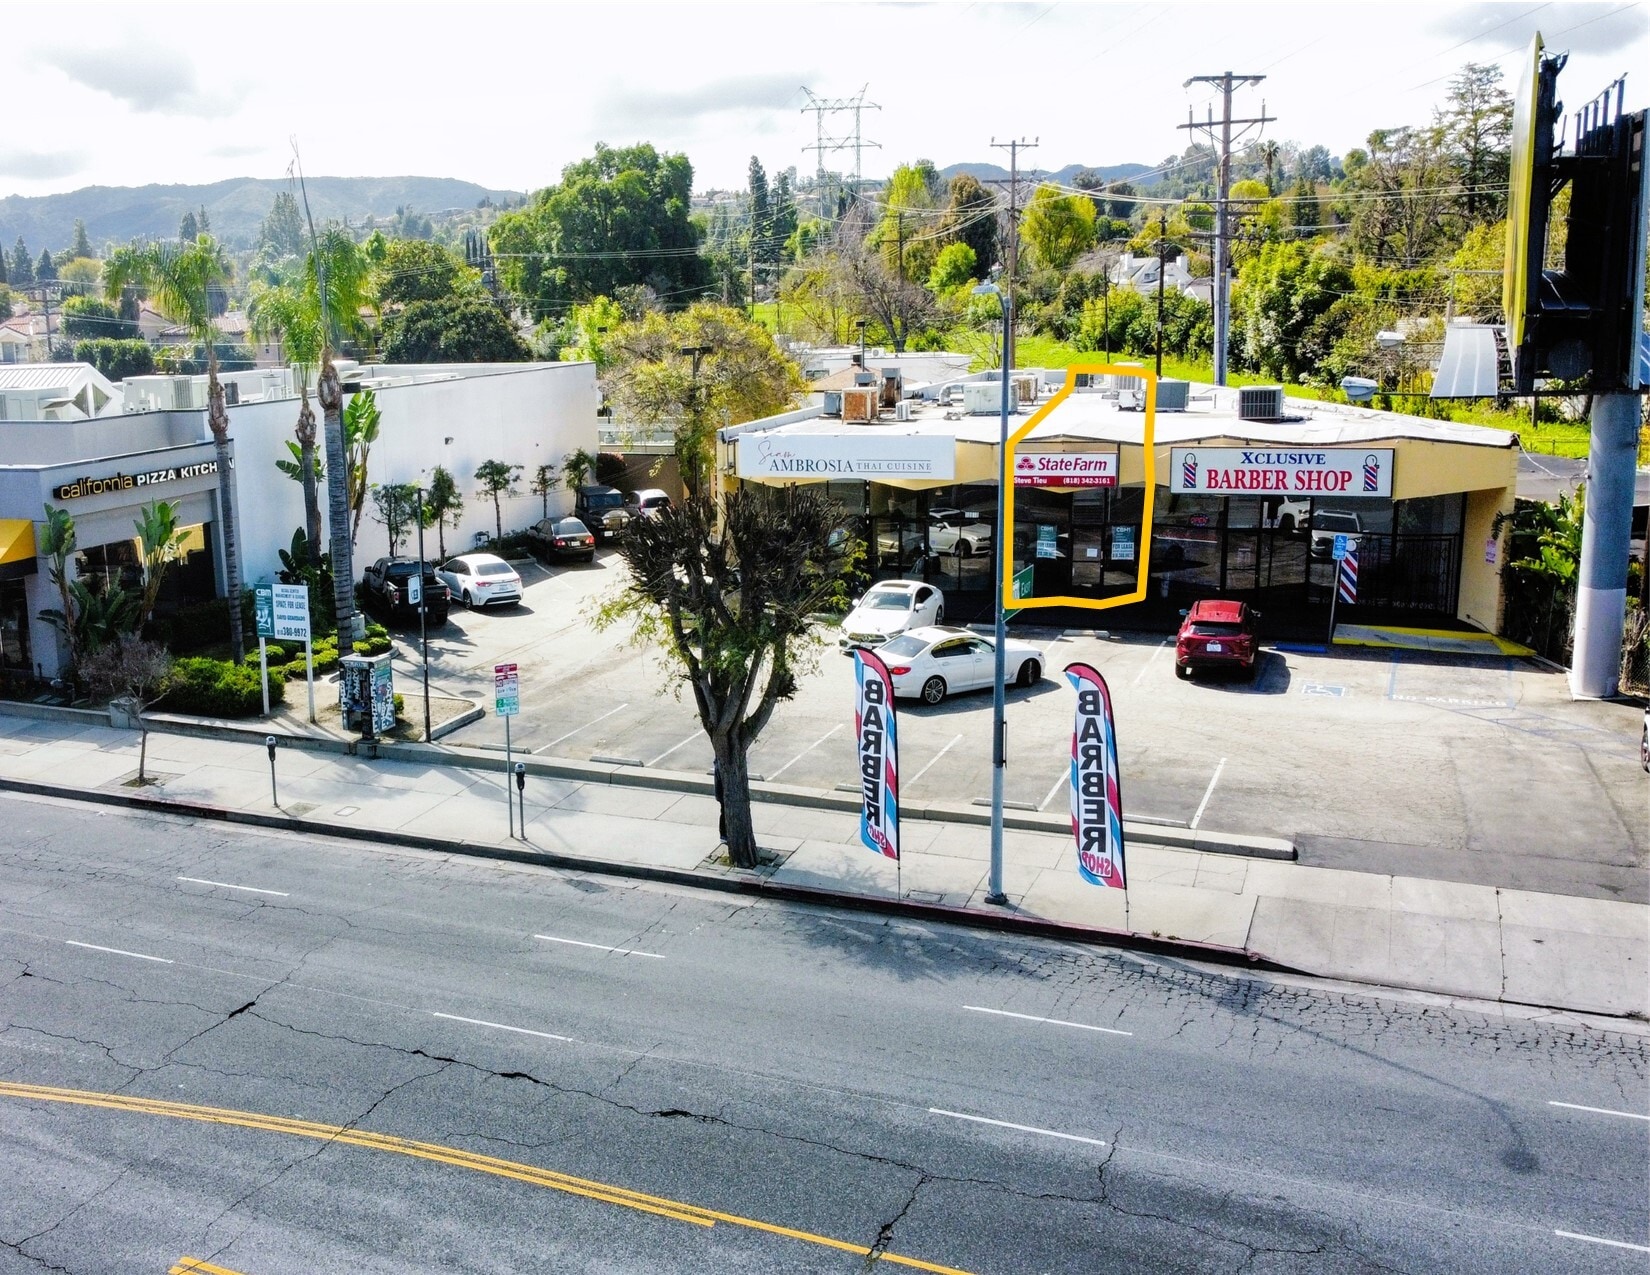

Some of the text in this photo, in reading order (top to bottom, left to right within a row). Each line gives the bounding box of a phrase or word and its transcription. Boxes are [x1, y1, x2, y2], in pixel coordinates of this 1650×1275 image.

[1240, 452, 1326, 465] XCLUSIVE
[769, 459, 854, 472] AMBROSIA
[856, 462, 932, 471] THAI CUISINE
[60, 458, 235, 499] california PIZZA KITCHN
[1063, 476, 1080, 485] (818)
[1206, 469, 1353, 491] BARBER SHOP
[275, 600, 287, 608] SPACE
[287, 601, 295, 609] FOR
[295, 601, 306, 610] LEASE
[1425, 696, 1507, 706] PARKING
